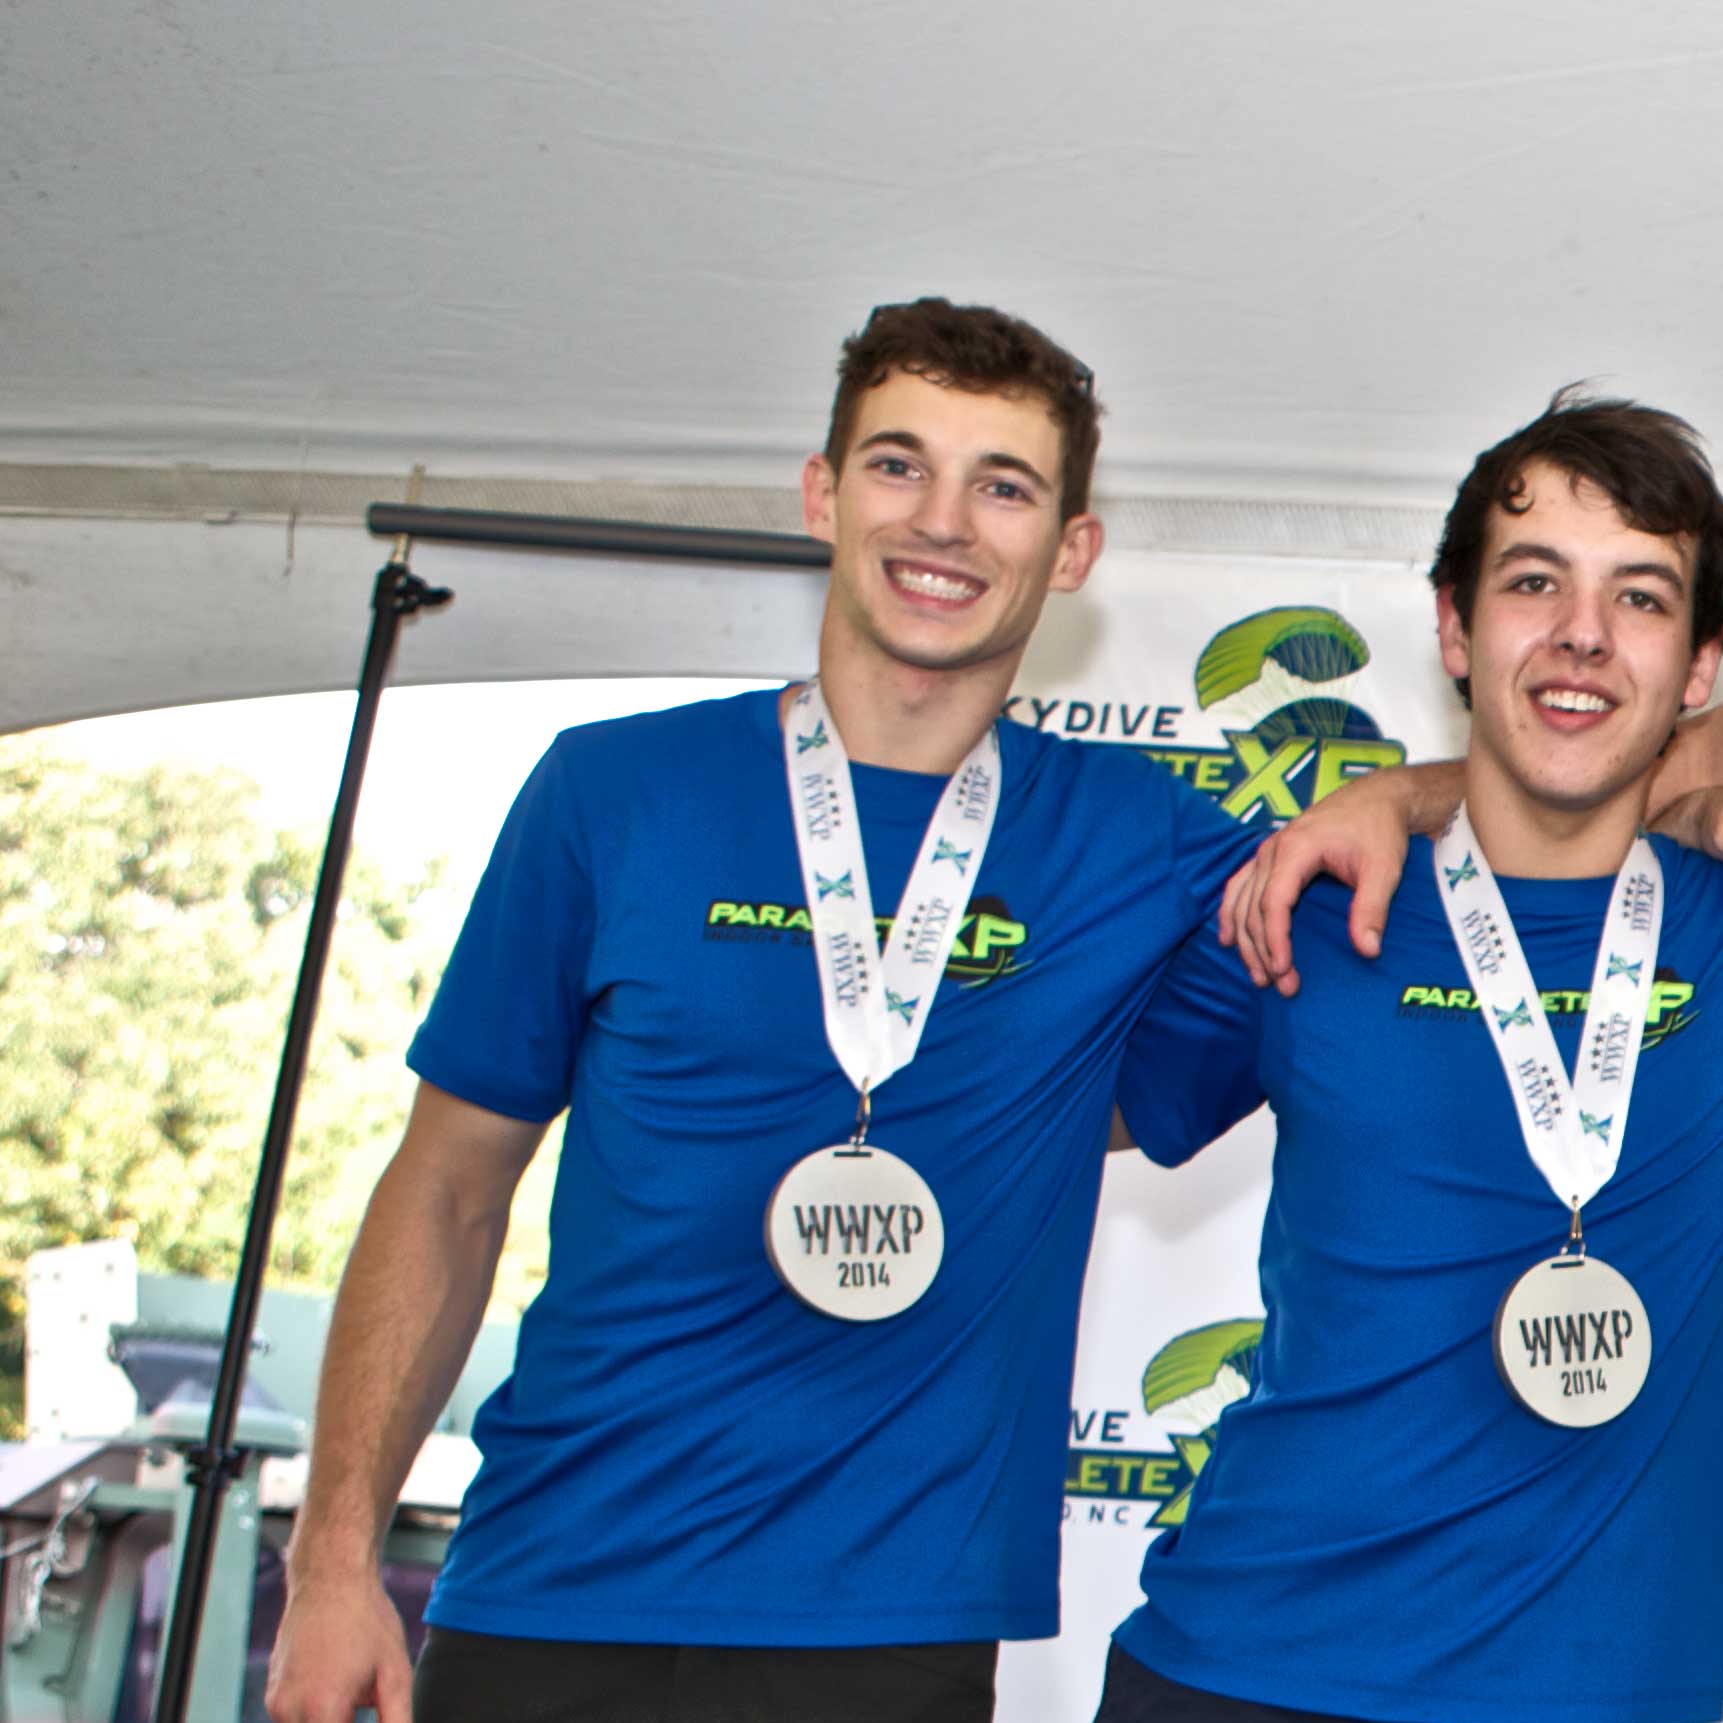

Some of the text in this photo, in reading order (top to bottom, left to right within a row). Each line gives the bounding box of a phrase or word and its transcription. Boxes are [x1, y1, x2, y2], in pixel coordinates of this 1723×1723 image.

[1002, 696, 1184, 739] KYDIVE
[793, 1204, 924, 1254] WWXP
[838, 1262, 891, 1288] 2014
[1519, 1310, 1633, 1368] WWXP
[1561, 1368, 1607, 1397] 2014
